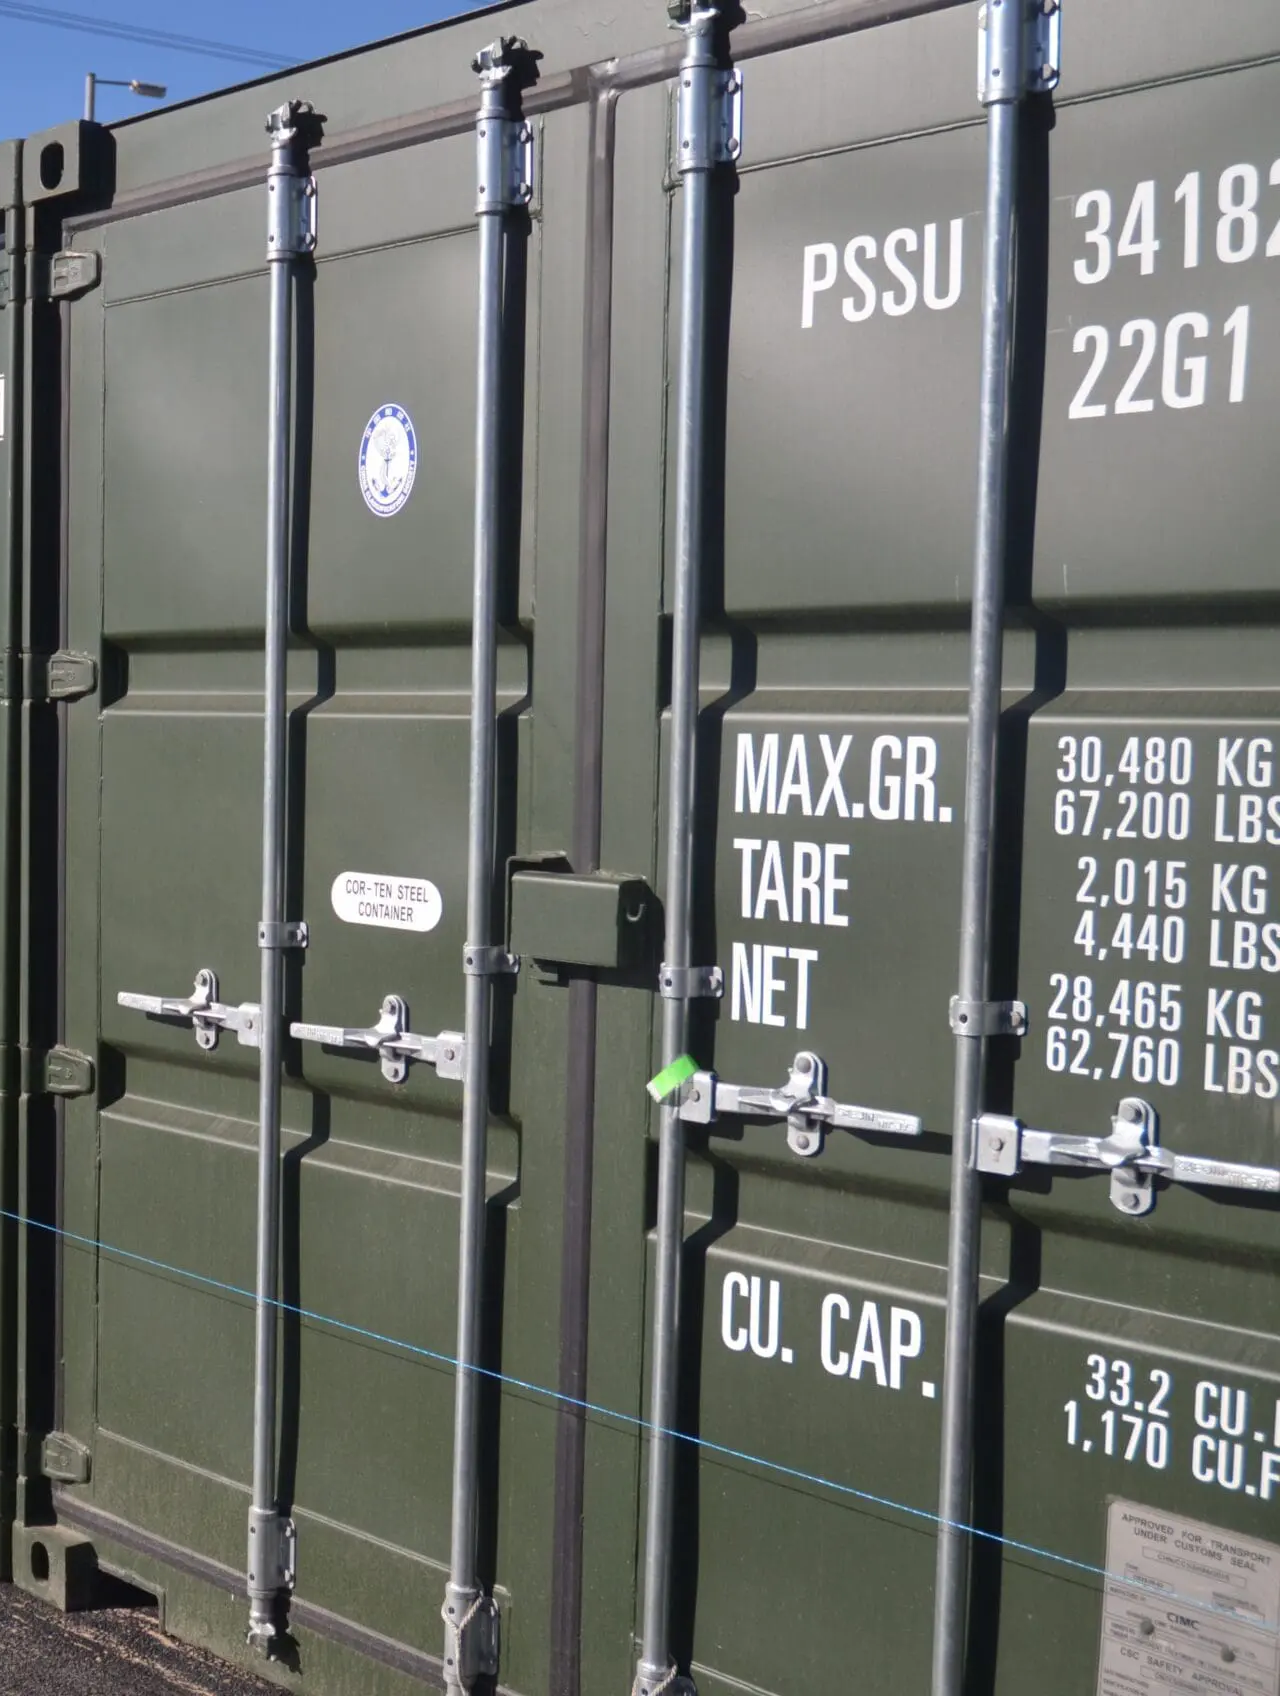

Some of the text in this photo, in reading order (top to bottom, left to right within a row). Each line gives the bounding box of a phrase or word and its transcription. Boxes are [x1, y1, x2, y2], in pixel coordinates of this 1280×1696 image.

[801, 218, 964, 328] PSSU
[1068, 305, 1250, 419] 22G1
[734, 733, 1273, 823] MAX.GR. 30,480 KG
[1054, 789, 1280, 845] 67,200 LBS
[345, 879, 429, 903] COR-TEN STEEL
[358, 901, 413, 922] CONTAINER
[733, 838, 1267, 927] TARE 2,015 KG
[1074, 910, 1280, 972] 4,440 LBS
[730, 943, 1263, 1041] NET 28,465 KG
[1046, 1026, 1280, 1099] 62,760 LBS
[721, 1272, 1280, 1448] CU. CAP. 33.2 CU.
[1064, 1400, 1169, 1470] 1,170
[1122, 1513, 1272, 1566] APPROVED FOR TRANSPORT
[1134, 1526, 1168, 1544] UNDER
[1174, 1539, 1223, 1561] CUSTOMS
[1230, 1556, 1258, 1573] SEAL
[1166, 1611, 1201, 1631] CIMC
[1120, 1646, 1140, 1660] CSC
[1146, 1654, 1183, 1675] SAFETY
